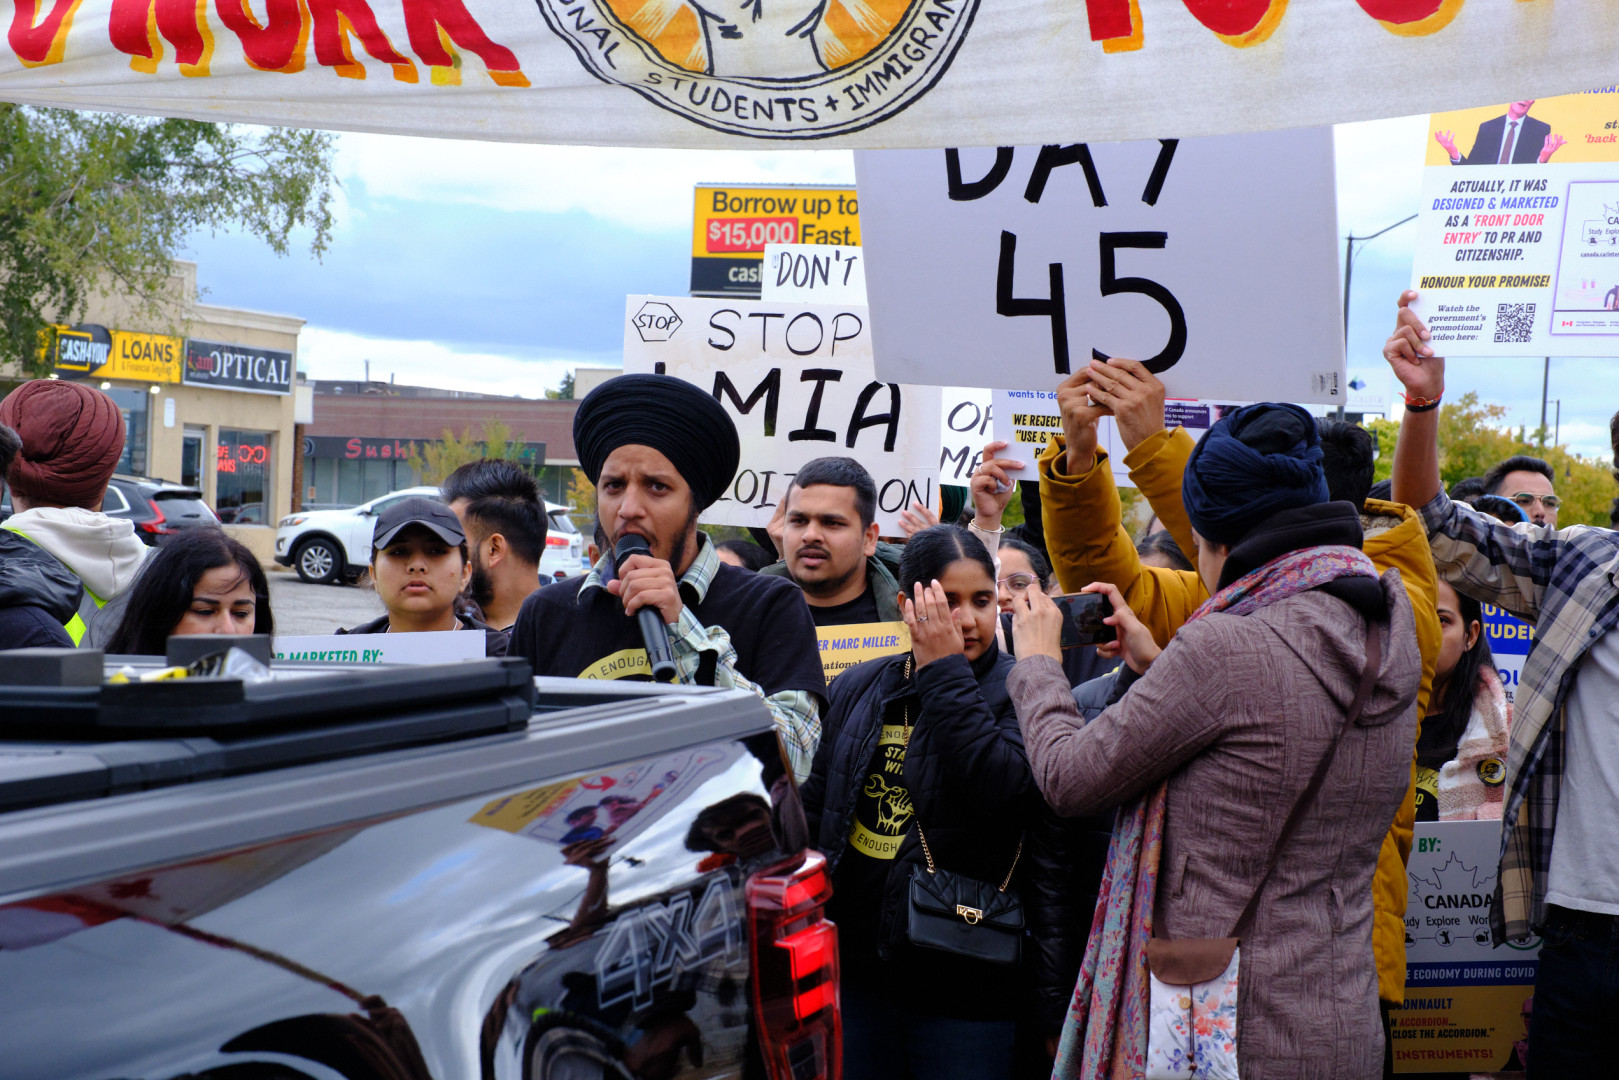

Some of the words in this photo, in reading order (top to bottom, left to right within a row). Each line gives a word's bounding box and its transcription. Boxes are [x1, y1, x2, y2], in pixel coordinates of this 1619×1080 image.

[643, 72, 819, 123] STUDENTS
[825, 95, 839, 111] +
[1450, 179, 1505, 194] ACTUALLY,
[1509, 179, 1520, 192] IT
[1523, 178, 1548, 192] WAS
[712, 190, 797, 214] Borrow
[802, 197, 832, 220] up
[837, 194, 859, 216] to
[1432, 198, 1485, 211] DESIGNED
[1487, 197, 1496, 210] &
[1499, 196, 1560, 210] MARKETED
[1444, 215, 1460, 228] AS
[1460, 214, 1469, 228] A
[1473, 213, 1512, 228] 'FRONT
[1513, 213, 1545, 227] DOOR
[708, 220, 795, 250] $15,000
[801, 224, 857, 246] Fast.
[1443, 230, 1483, 245] ENTRY'
[1483, 230, 1498, 244] TO
[1499, 230, 1515, 244] PR
[1517, 230, 1543, 243] AND
[1455, 248, 1524, 262] CITIZENSHIP.
[776, 249, 858, 289] DON'T
[1420, 276, 1465, 289] HONOUR
[1467, 276, 1496, 288] YOUR
[1500, 275, 1551, 288] PROMISE!
[996, 229, 1188, 376] 45
[1437, 304, 1464, 312] Watch
[1466, 304, 1480, 312] the
[637, 313, 679, 331] STOP
[1428, 314, 1486, 322] government's
[707, 308, 863, 357] STOP
[1430, 324, 1483, 333] promotional
[1432, 333, 1455, 341] video
[1456, 333, 1479, 341] here:
[122, 339, 174, 363] LOANS
[209, 350, 290, 385] OPTICAL
[1008, 390, 1035, 399] wants
[1036, 390, 1046, 399] to
[654, 362, 901, 452] MIA
[1014, 413, 1028, 426] WE
[1029, 414, 1062, 428] REJECT
[1016, 429, 1038, 443] "USE
[1040, 431, 1047, 444] &
[831, 638, 860, 651] MARC
[862, 635, 900, 649] MILLER:
[1418, 837, 1442, 853] BY:
[1424, 893, 1494, 910] CANADA
[1426, 916, 1461, 927] Explore
[1413, 968, 1461, 981] ECONOMY
[1463, 967, 1502, 979] DURING
[1504, 966, 1536, 978] COVID
[1399, 1017, 1457, 1028] ACCORDION...
[1392, 1029, 1418, 1040] CLOSE
[1419, 1029, 1436, 1039] THE
[1437, 1027, 1496, 1039] ACCORDION."
[1396, 1049, 1494, 1061] INSTRUMENTS!
